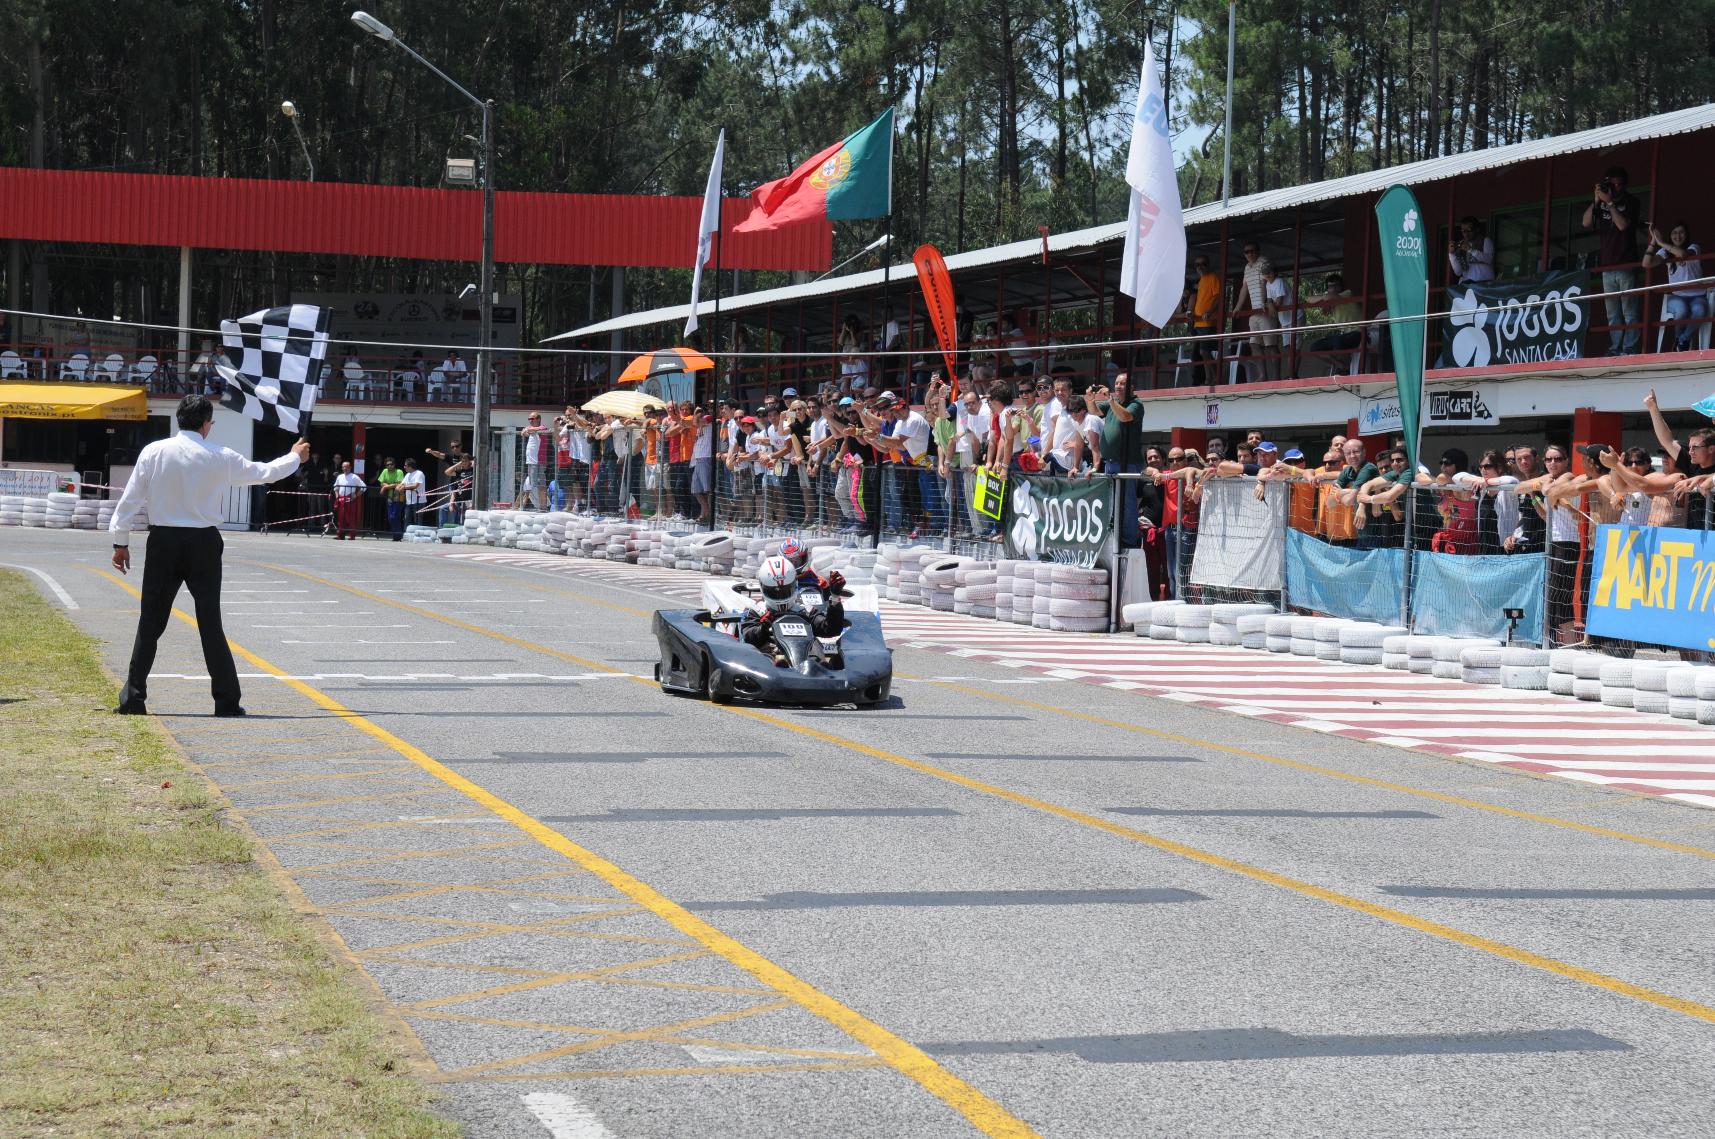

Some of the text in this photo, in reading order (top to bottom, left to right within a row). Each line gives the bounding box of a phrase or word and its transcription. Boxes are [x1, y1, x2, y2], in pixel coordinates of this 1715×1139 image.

[1495, 285, 1582, 358] JOGOS
[987, 478, 1000, 492] BOX
[1040, 497, 1104, 554] JOGOS
[1593, 528, 1695, 610] KART
